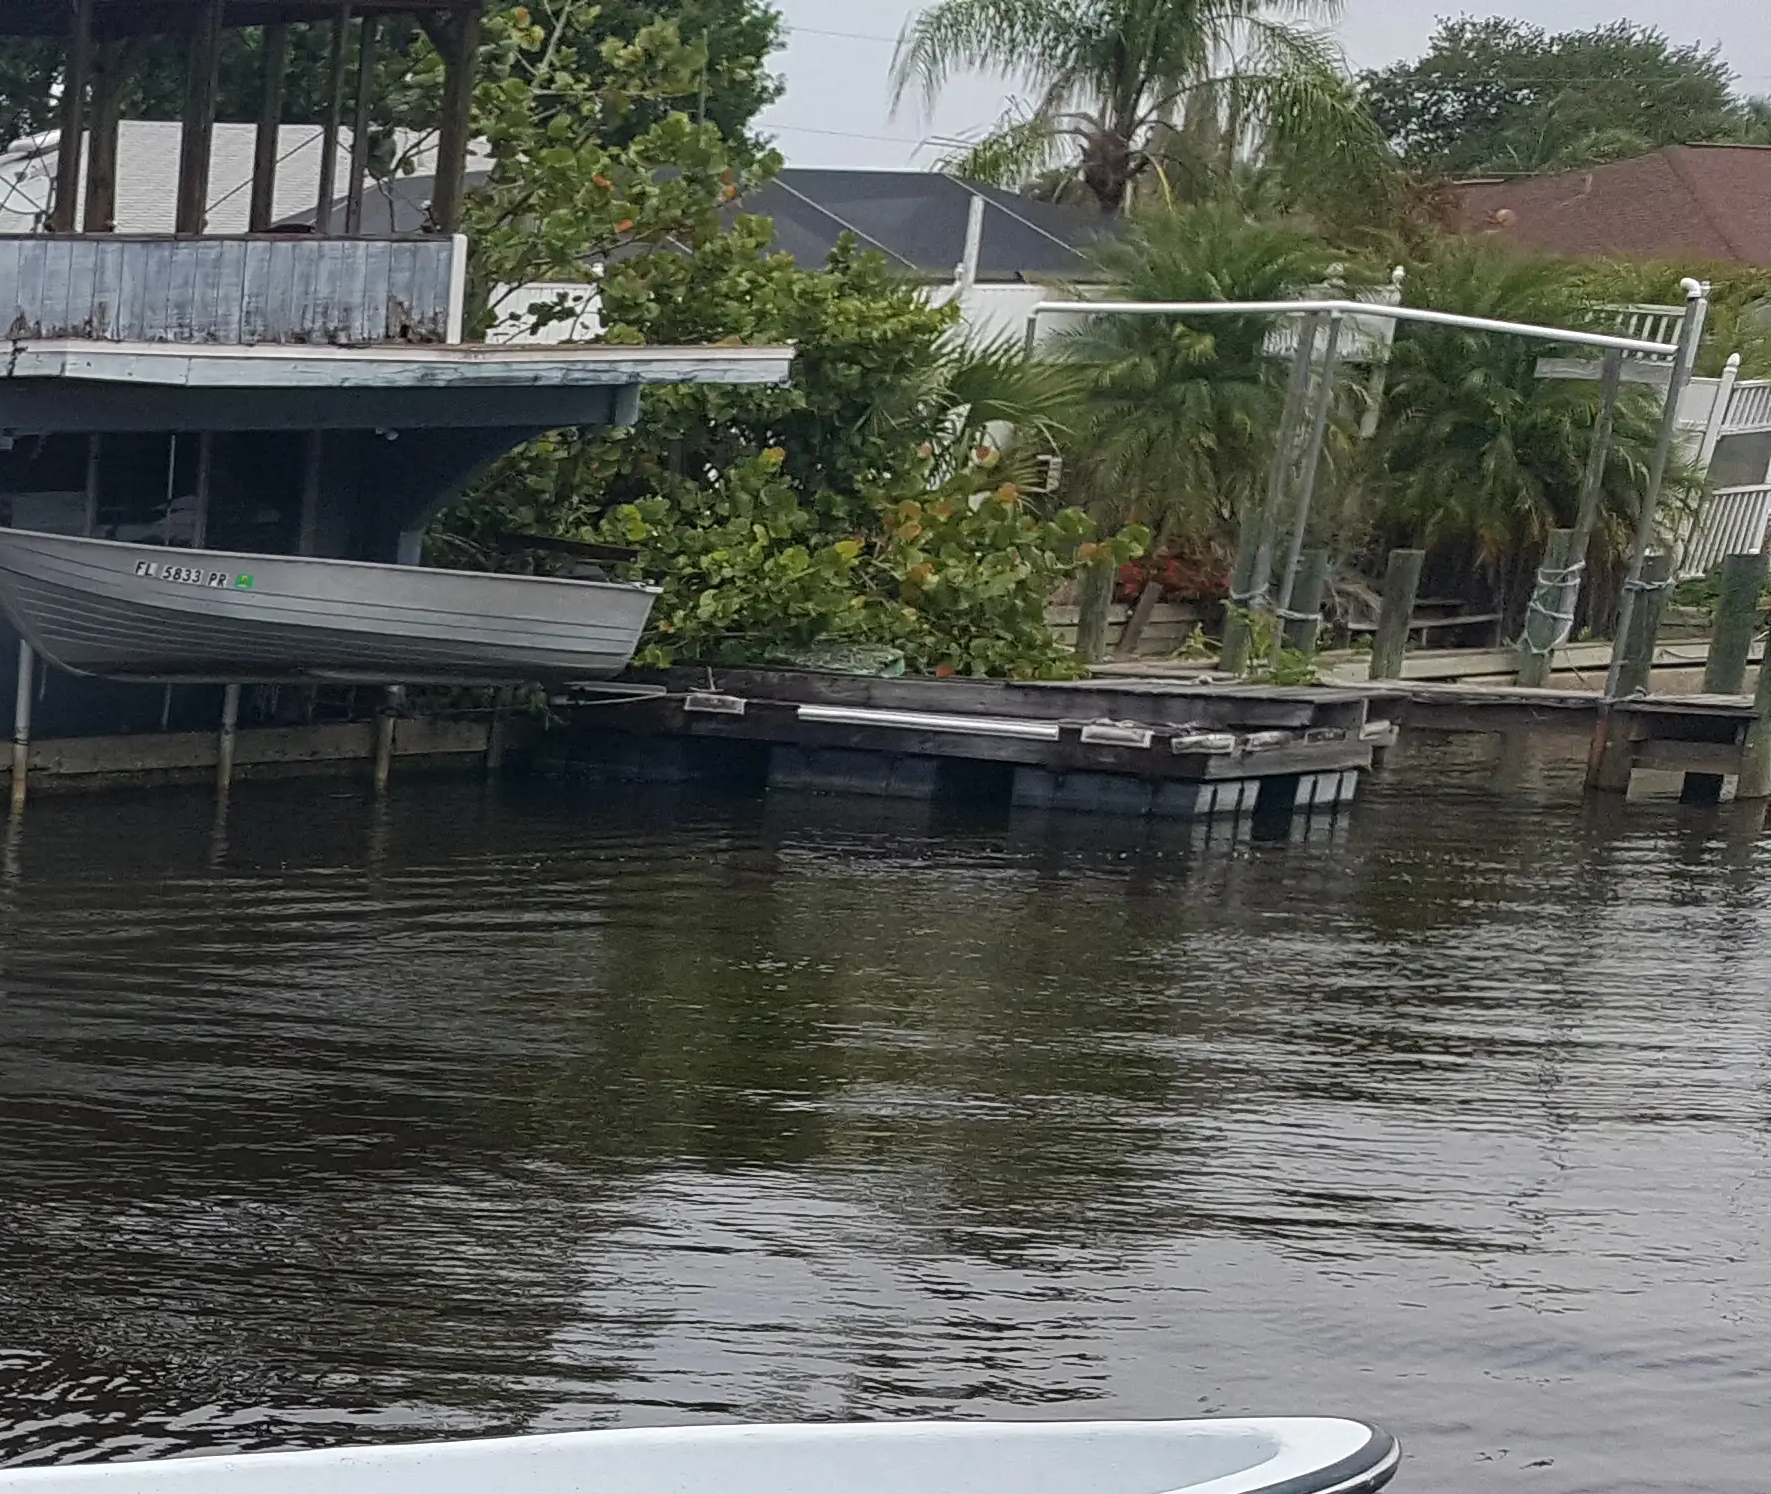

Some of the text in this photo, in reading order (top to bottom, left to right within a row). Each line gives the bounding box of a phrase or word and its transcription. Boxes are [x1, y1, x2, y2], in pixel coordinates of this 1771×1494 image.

[135, 561, 228, 588] FL 5833 PR
